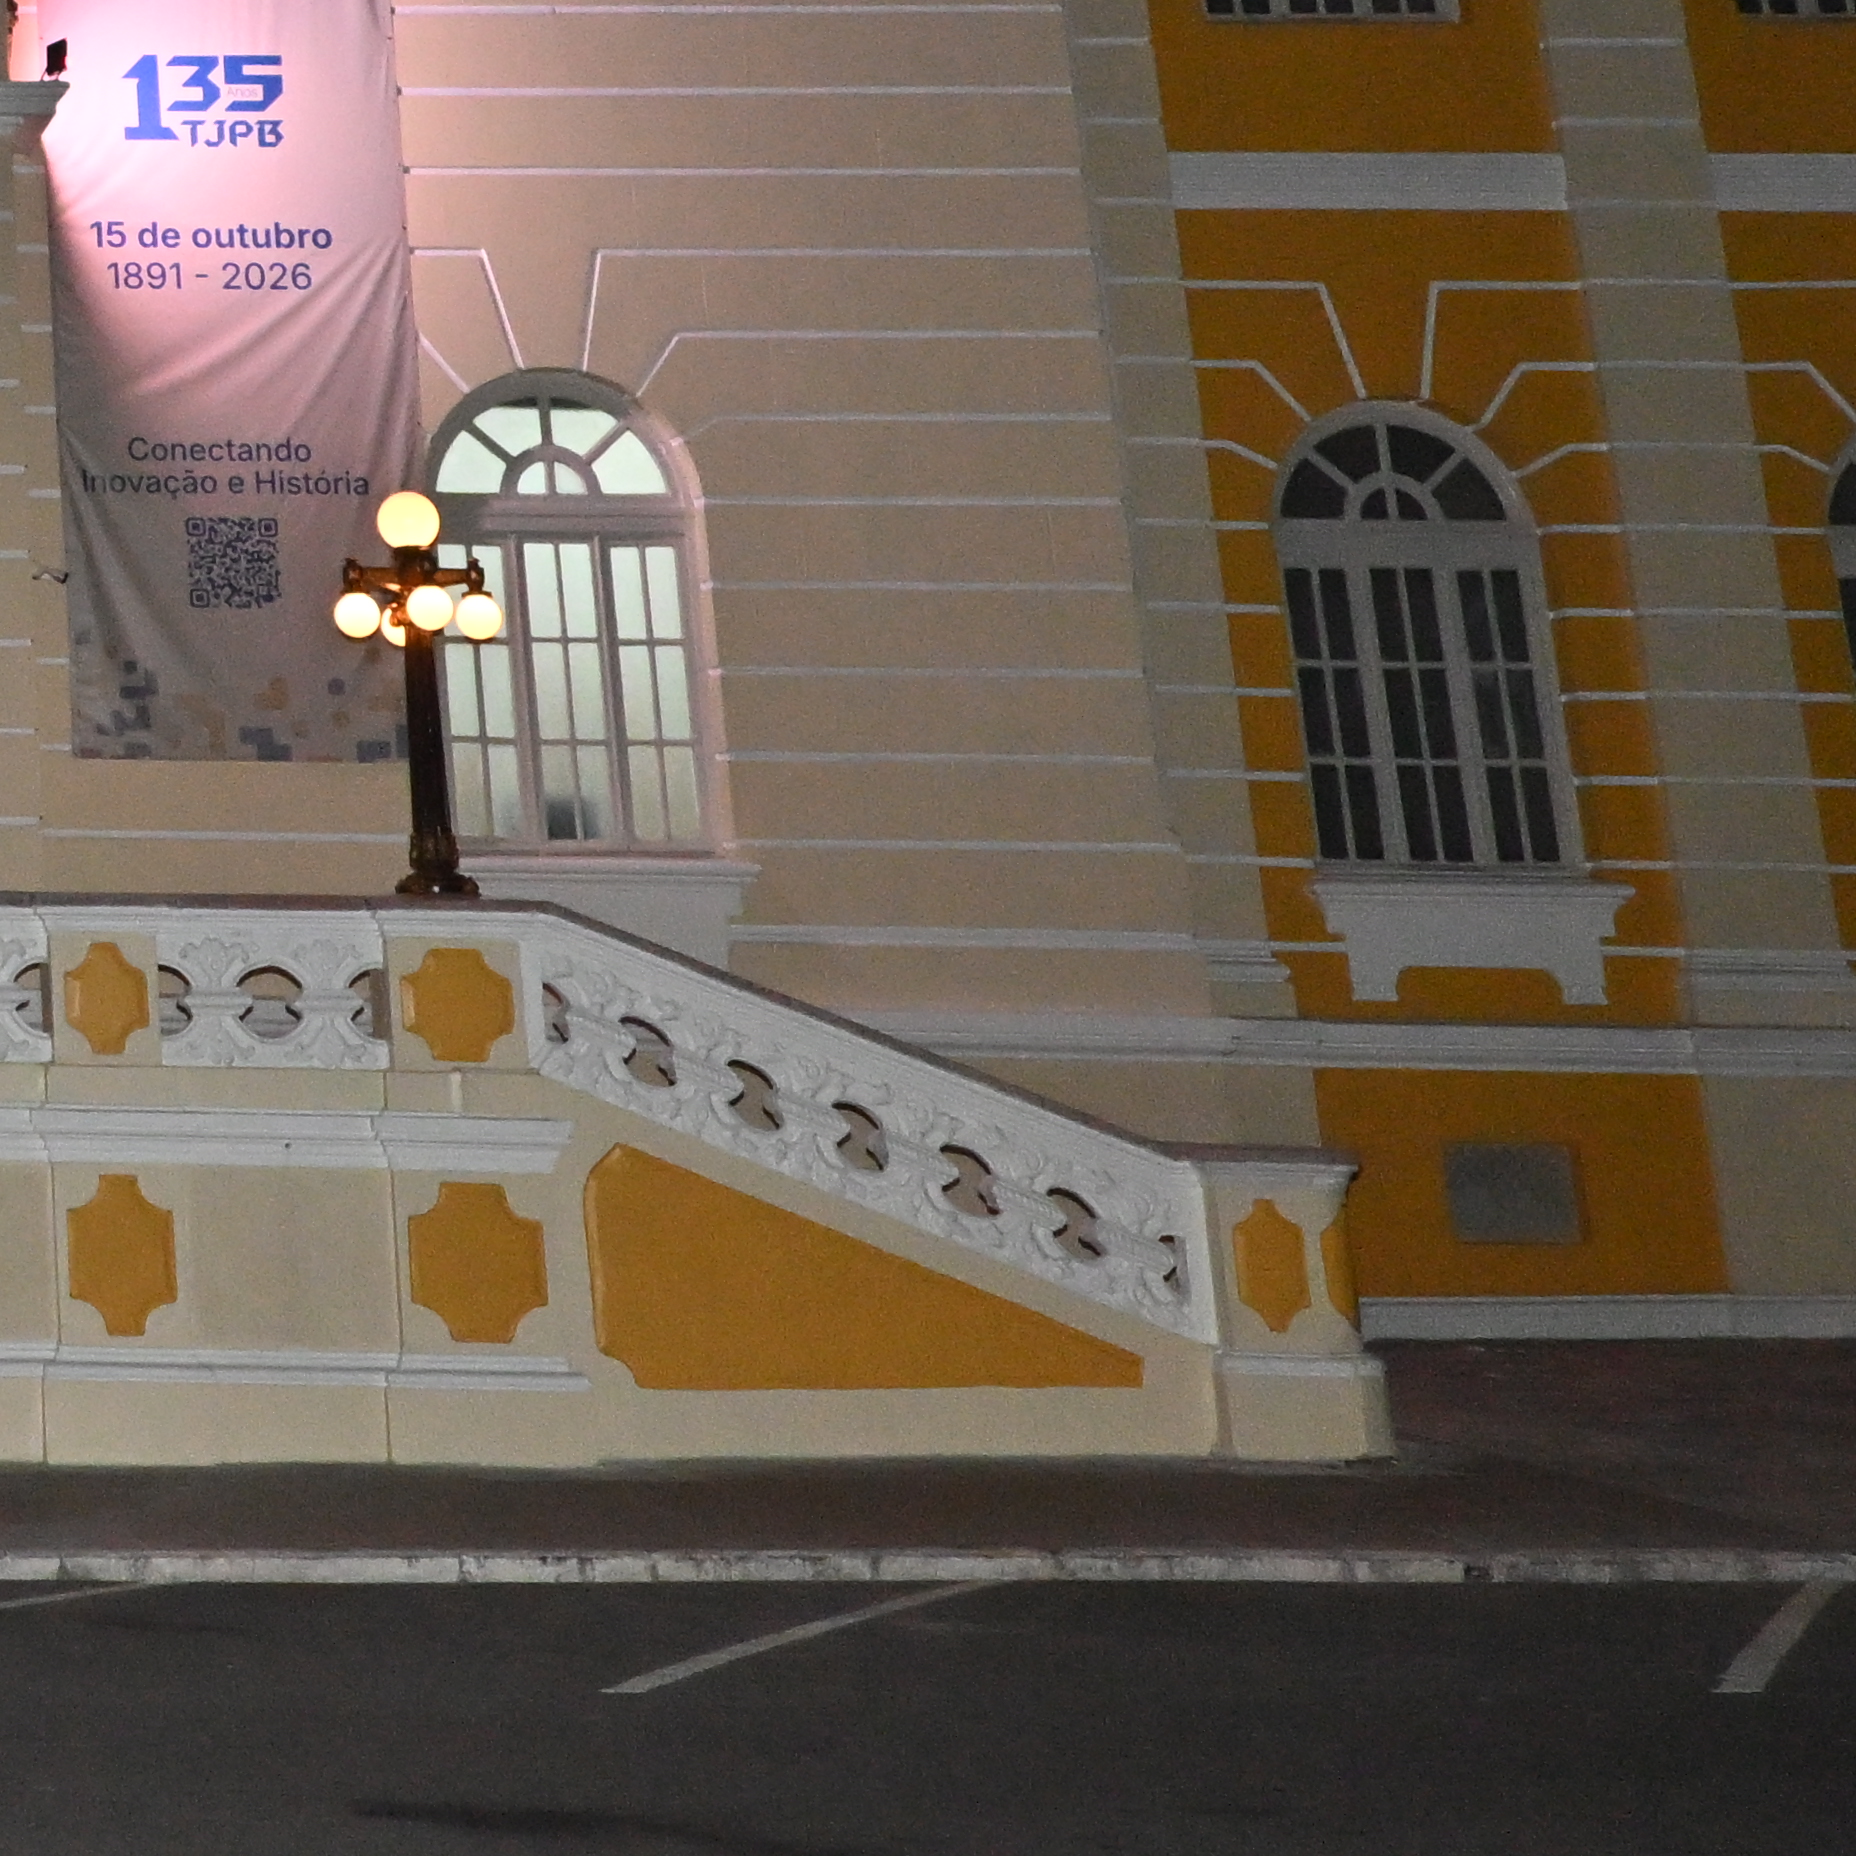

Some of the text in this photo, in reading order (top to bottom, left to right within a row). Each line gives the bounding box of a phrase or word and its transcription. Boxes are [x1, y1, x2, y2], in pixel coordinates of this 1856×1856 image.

[121, 54, 284, 141] 135
[227, 87, 258, 98] Anos
[180, 119, 285, 148] TJPB
[90, 221, 333, 249] 15 de outubro
[107, 262, 182, 290] 1891
[222, 262, 312, 290] 2026
[127, 437, 312, 463] Conectando
[81, 468, 370, 499] Inovação e História
